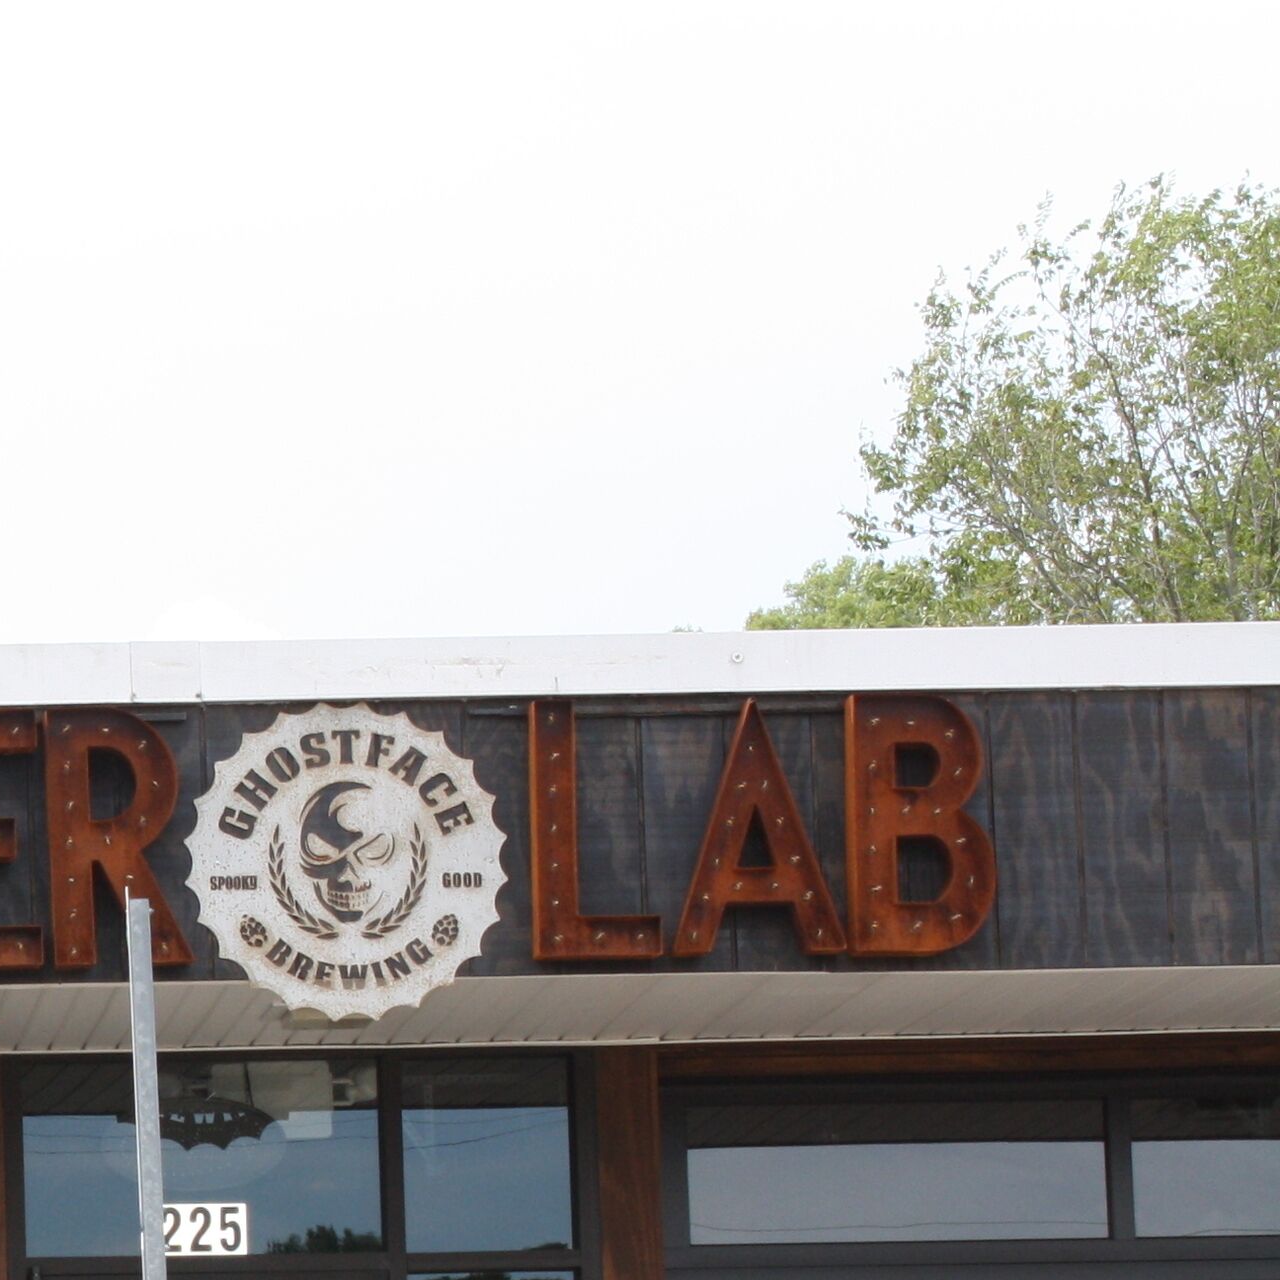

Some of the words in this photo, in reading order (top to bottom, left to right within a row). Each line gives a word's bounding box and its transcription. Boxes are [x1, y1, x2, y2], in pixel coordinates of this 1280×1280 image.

[218, 730, 475, 839] GHOSTFACE
[528, 694, 996, 959] LAB
[209, 875, 258, 891] SPOOKY
[442, 872, 483, 888] GOOD
[265, 937, 435, 991] BREWING
[163, 1207, 241, 1252] 225
